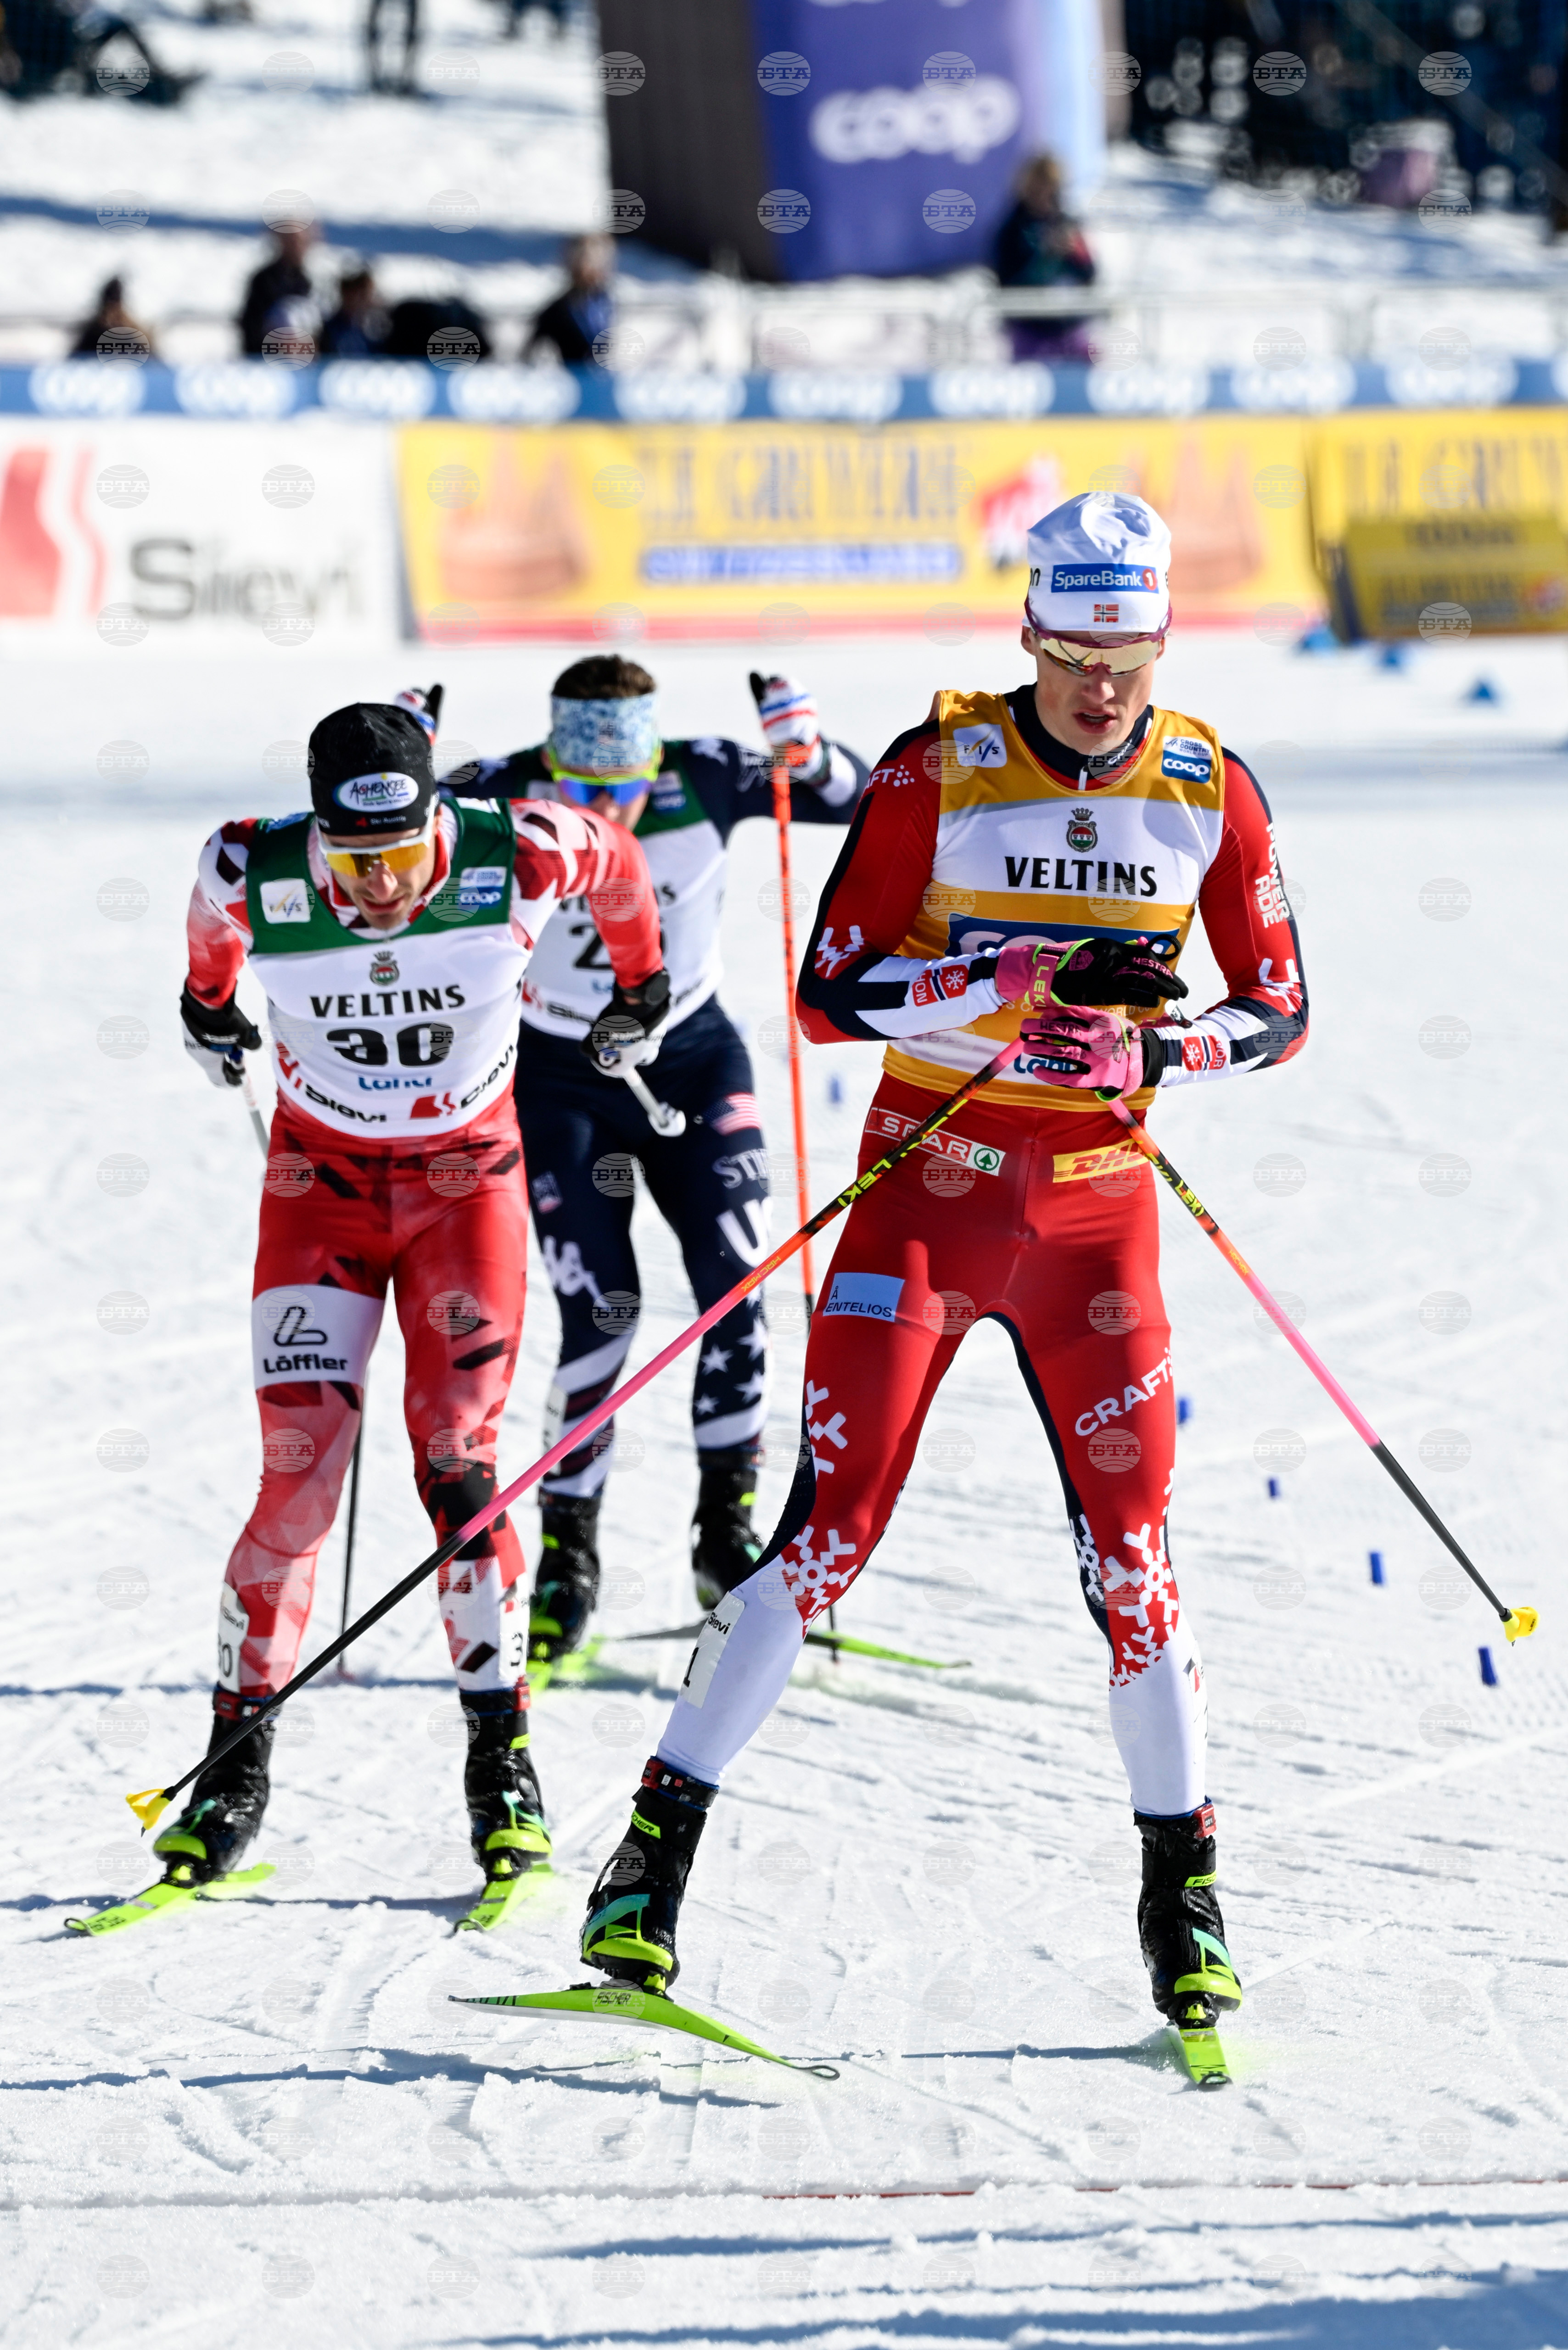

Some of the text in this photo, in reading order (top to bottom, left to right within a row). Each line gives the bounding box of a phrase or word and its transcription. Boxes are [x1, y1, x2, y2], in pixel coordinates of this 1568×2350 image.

[1054, 571, 1142, 589] SpareBank
[1180, 739, 1203, 748] CROSS
[1180, 744, 1210, 754] COUNTRY
[1163, 758, 1210, 776] coop
[1004, 856, 1157, 897] VELTINS
[1132, 956, 1174, 979] HESTRA
[1034, 966, 1050, 1007] LEKI
[310, 985, 465, 1018] VELTINS
[1040, 1020, 1081, 1035] HESTRA
[326, 1022, 454, 1068] 30
[838, 1158, 892, 1207] LEKI
[1175, 1180, 1204, 1216] LEKI
[825, 1302, 892, 1318] ENTELIOS
[1075, 1358, 1169, 1436] CRAFT
[708, 1612, 731, 1635] Sievi
[595, 1992, 632, 2005] FISCHER
